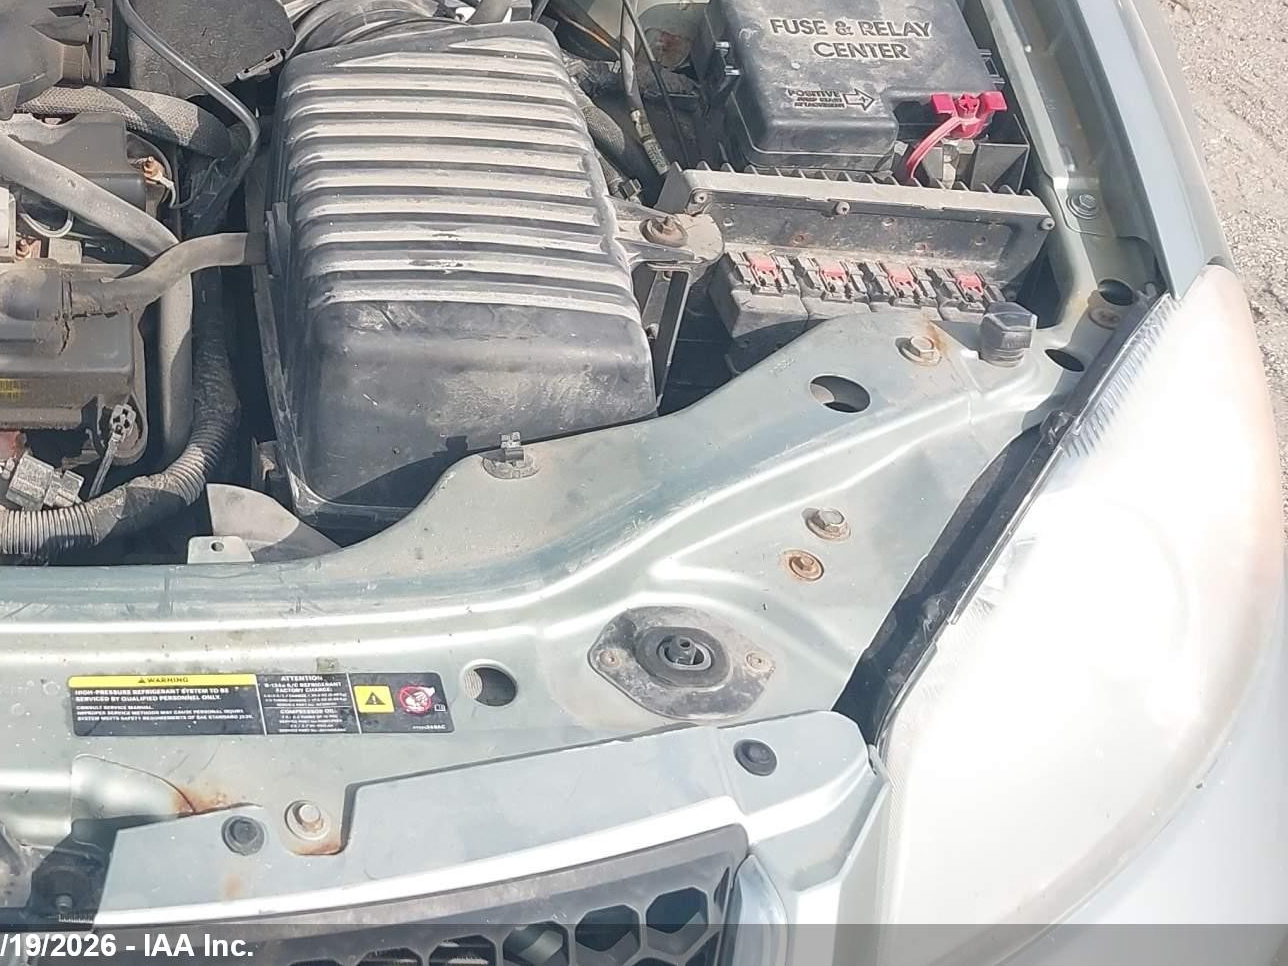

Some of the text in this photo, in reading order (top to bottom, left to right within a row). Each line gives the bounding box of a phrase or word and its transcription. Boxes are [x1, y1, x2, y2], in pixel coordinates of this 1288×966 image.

[770, 18, 932, 38] FUSE & RELAY
[813, 41, 911, 59] CENTER
